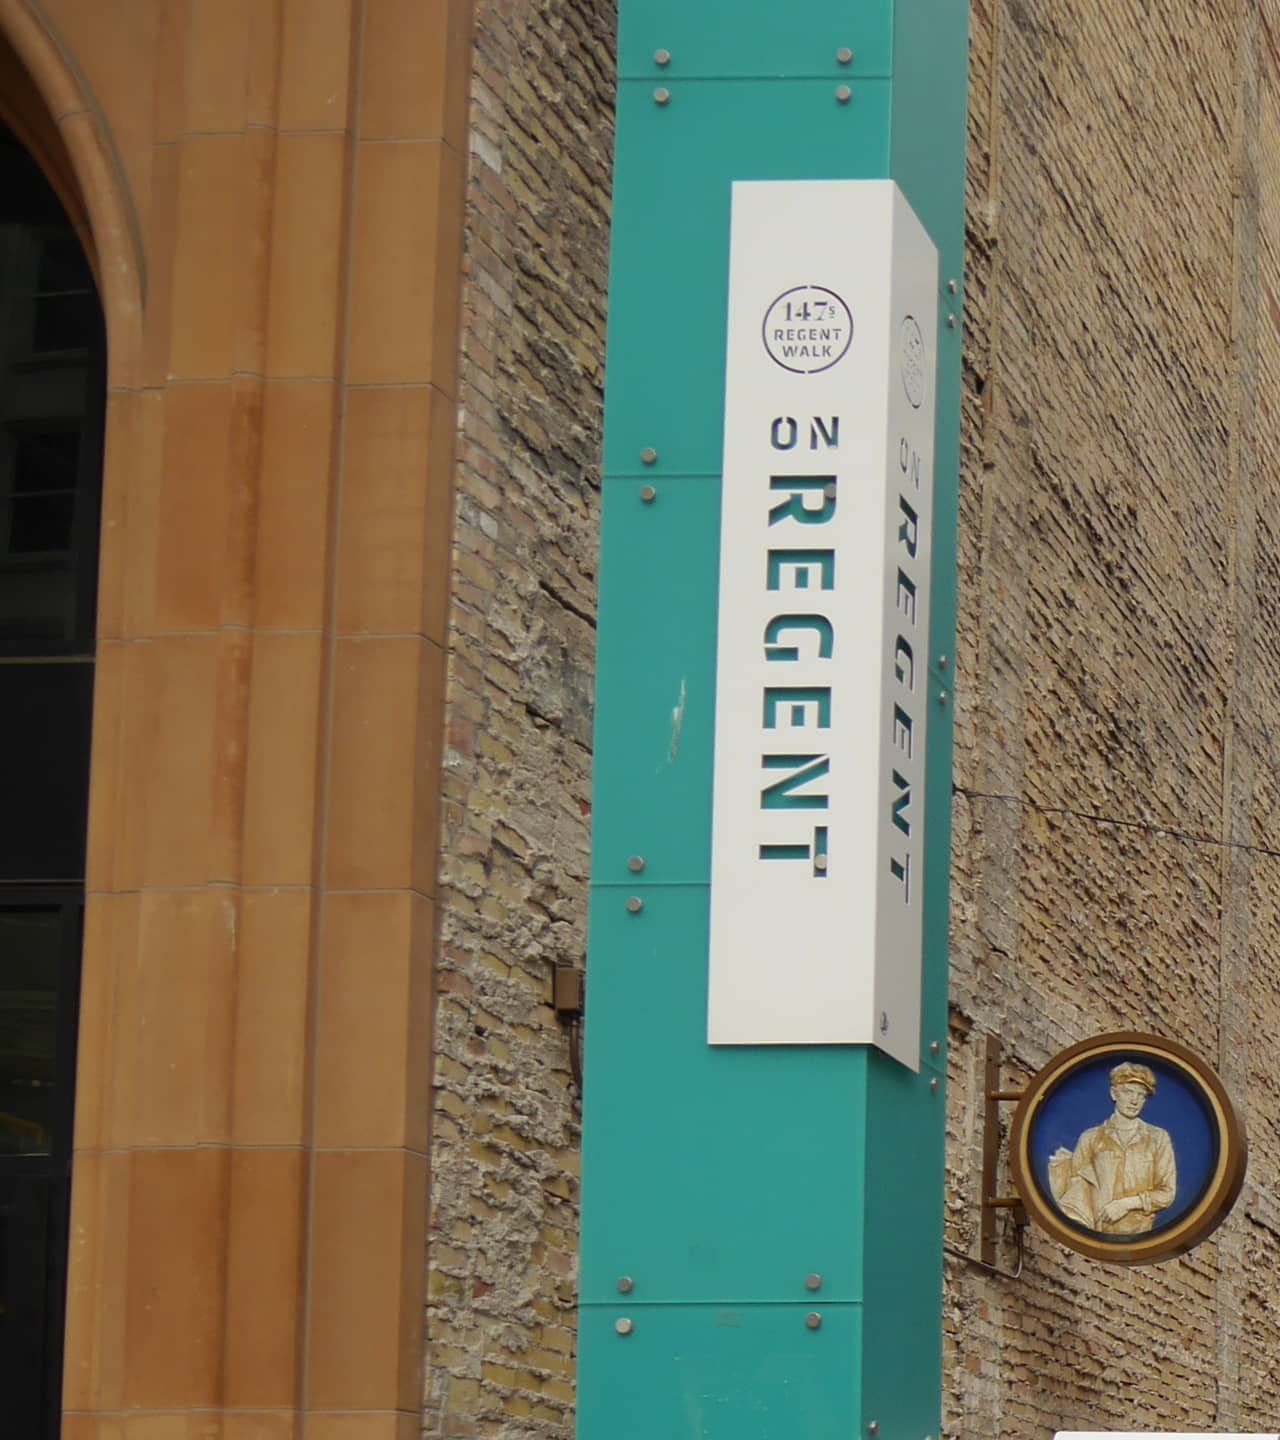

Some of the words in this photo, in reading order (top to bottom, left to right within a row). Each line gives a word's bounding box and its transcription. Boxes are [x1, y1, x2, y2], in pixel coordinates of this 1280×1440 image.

[774, 328, 842, 341] REGENT
[782, 344, 832, 358] WALK
[770, 416, 839, 451] ON
[759, 475, 838, 878] REGENT
[890, 493, 919, 904] REGENT
